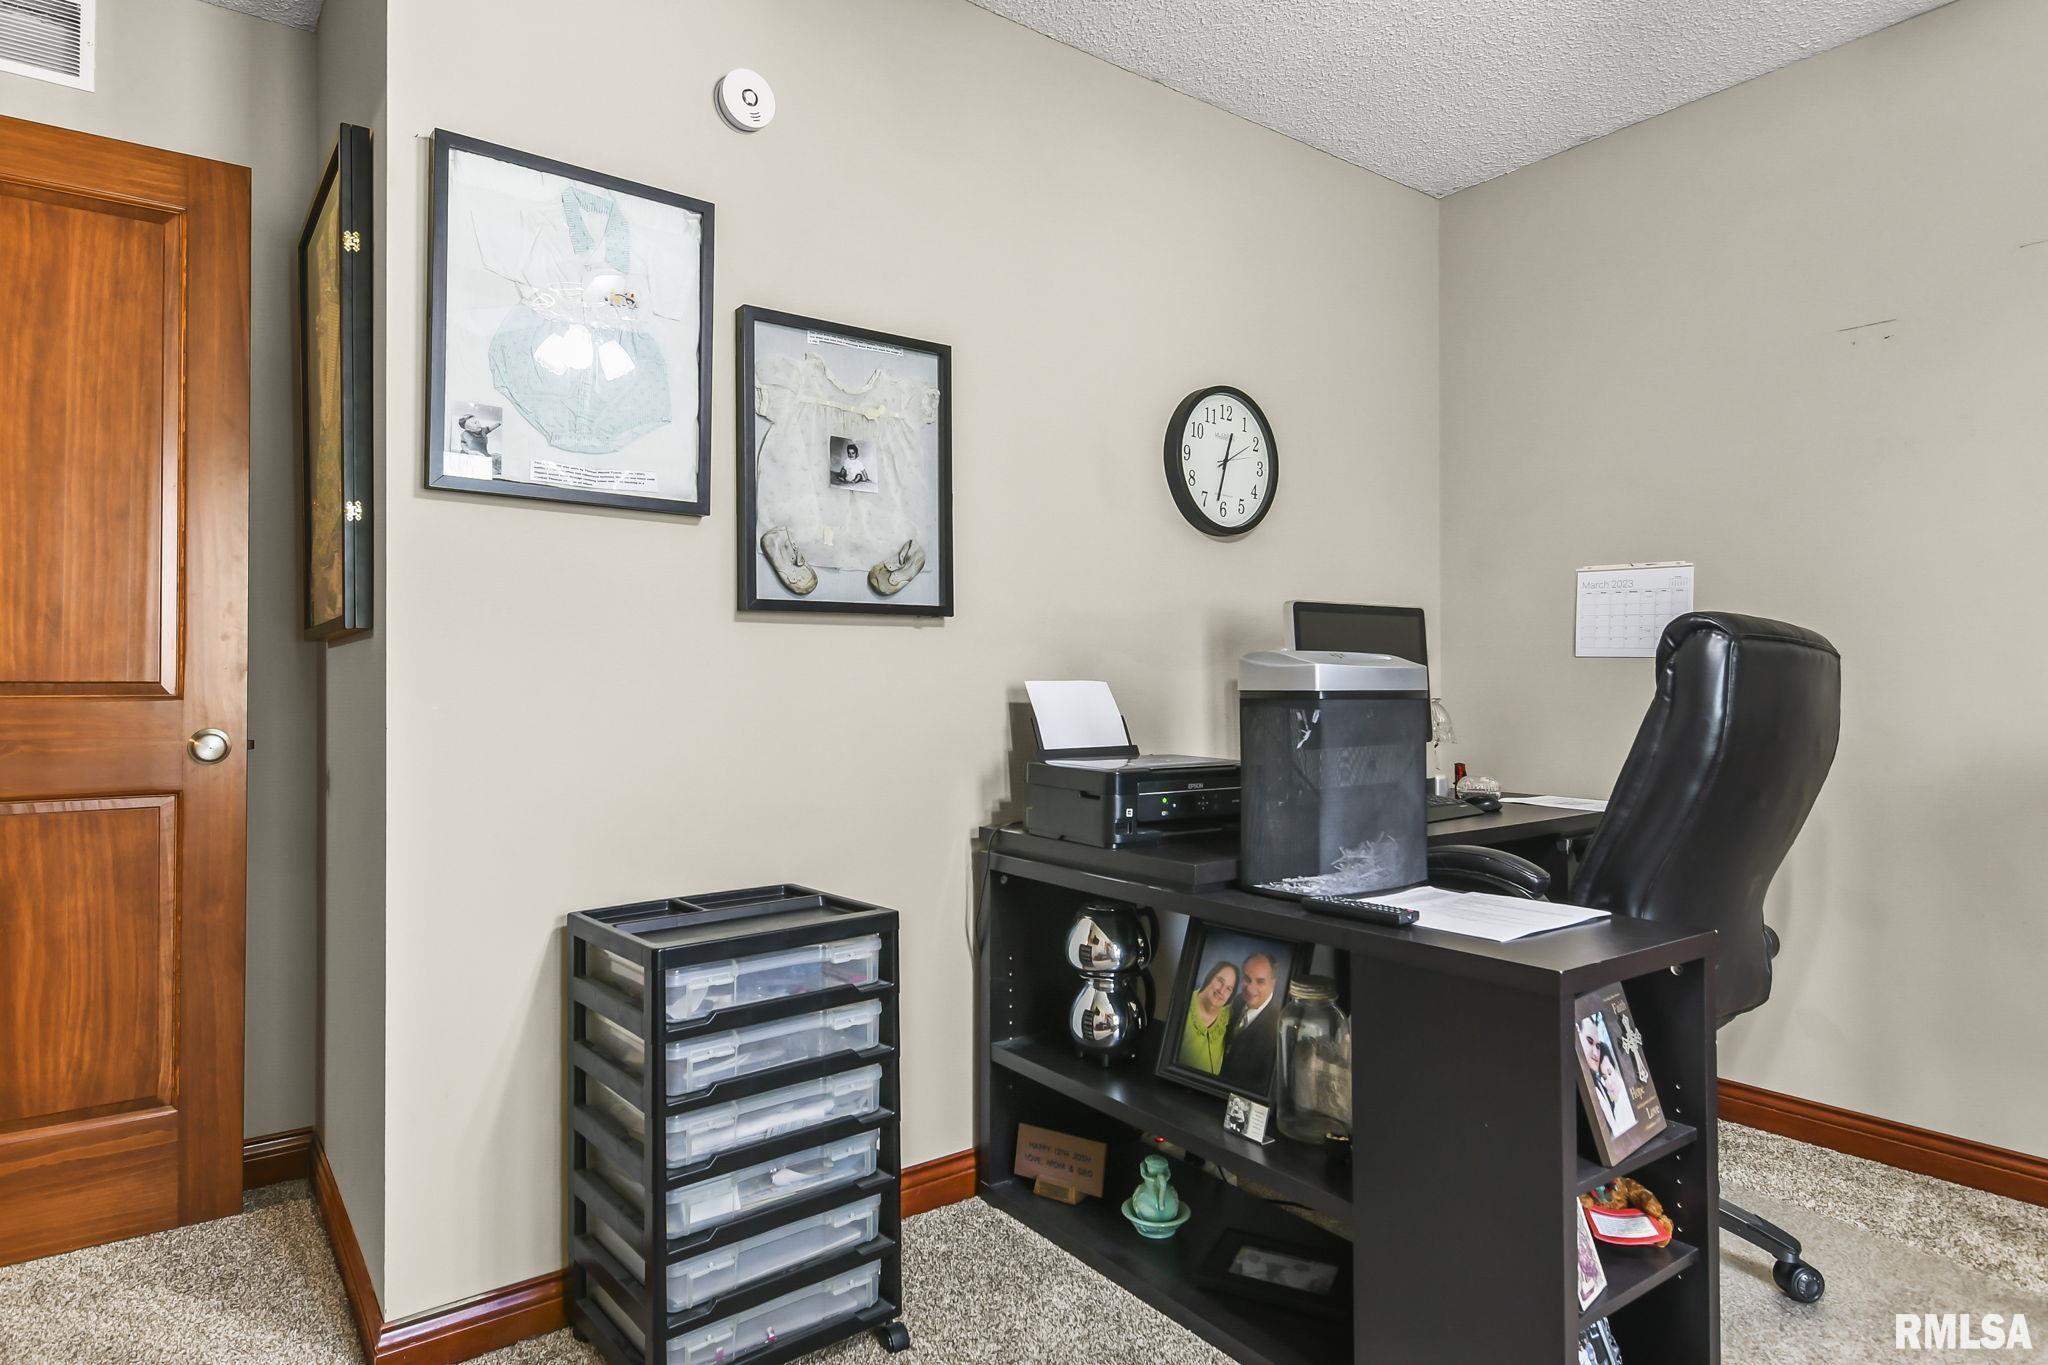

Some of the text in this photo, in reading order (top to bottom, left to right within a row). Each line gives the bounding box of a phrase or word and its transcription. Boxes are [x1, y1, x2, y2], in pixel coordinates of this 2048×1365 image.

[1205, 407, 1217, 424] 11
[1220, 404, 1233, 421] 12
[1191, 421, 1204, 439] 10
[1242, 417, 1247, 432] 1
[1253, 436, 1259, 452] 2
[1183, 445, 1191, 461] 9
[1256, 461, 1263, 477] 3
[1188, 469, 1196, 486] 8
[1201, 490, 1208, 507] 7
[1250, 484, 1258, 499] 4
[1219, 501, 1227, 517] 6
[1238, 498, 1245, 514] 5
[1582, 580, 1633, 590] March 2023
[1630, 1086, 1645, 1100] Hope
[1645, 1105, 1660, 1120] Love
